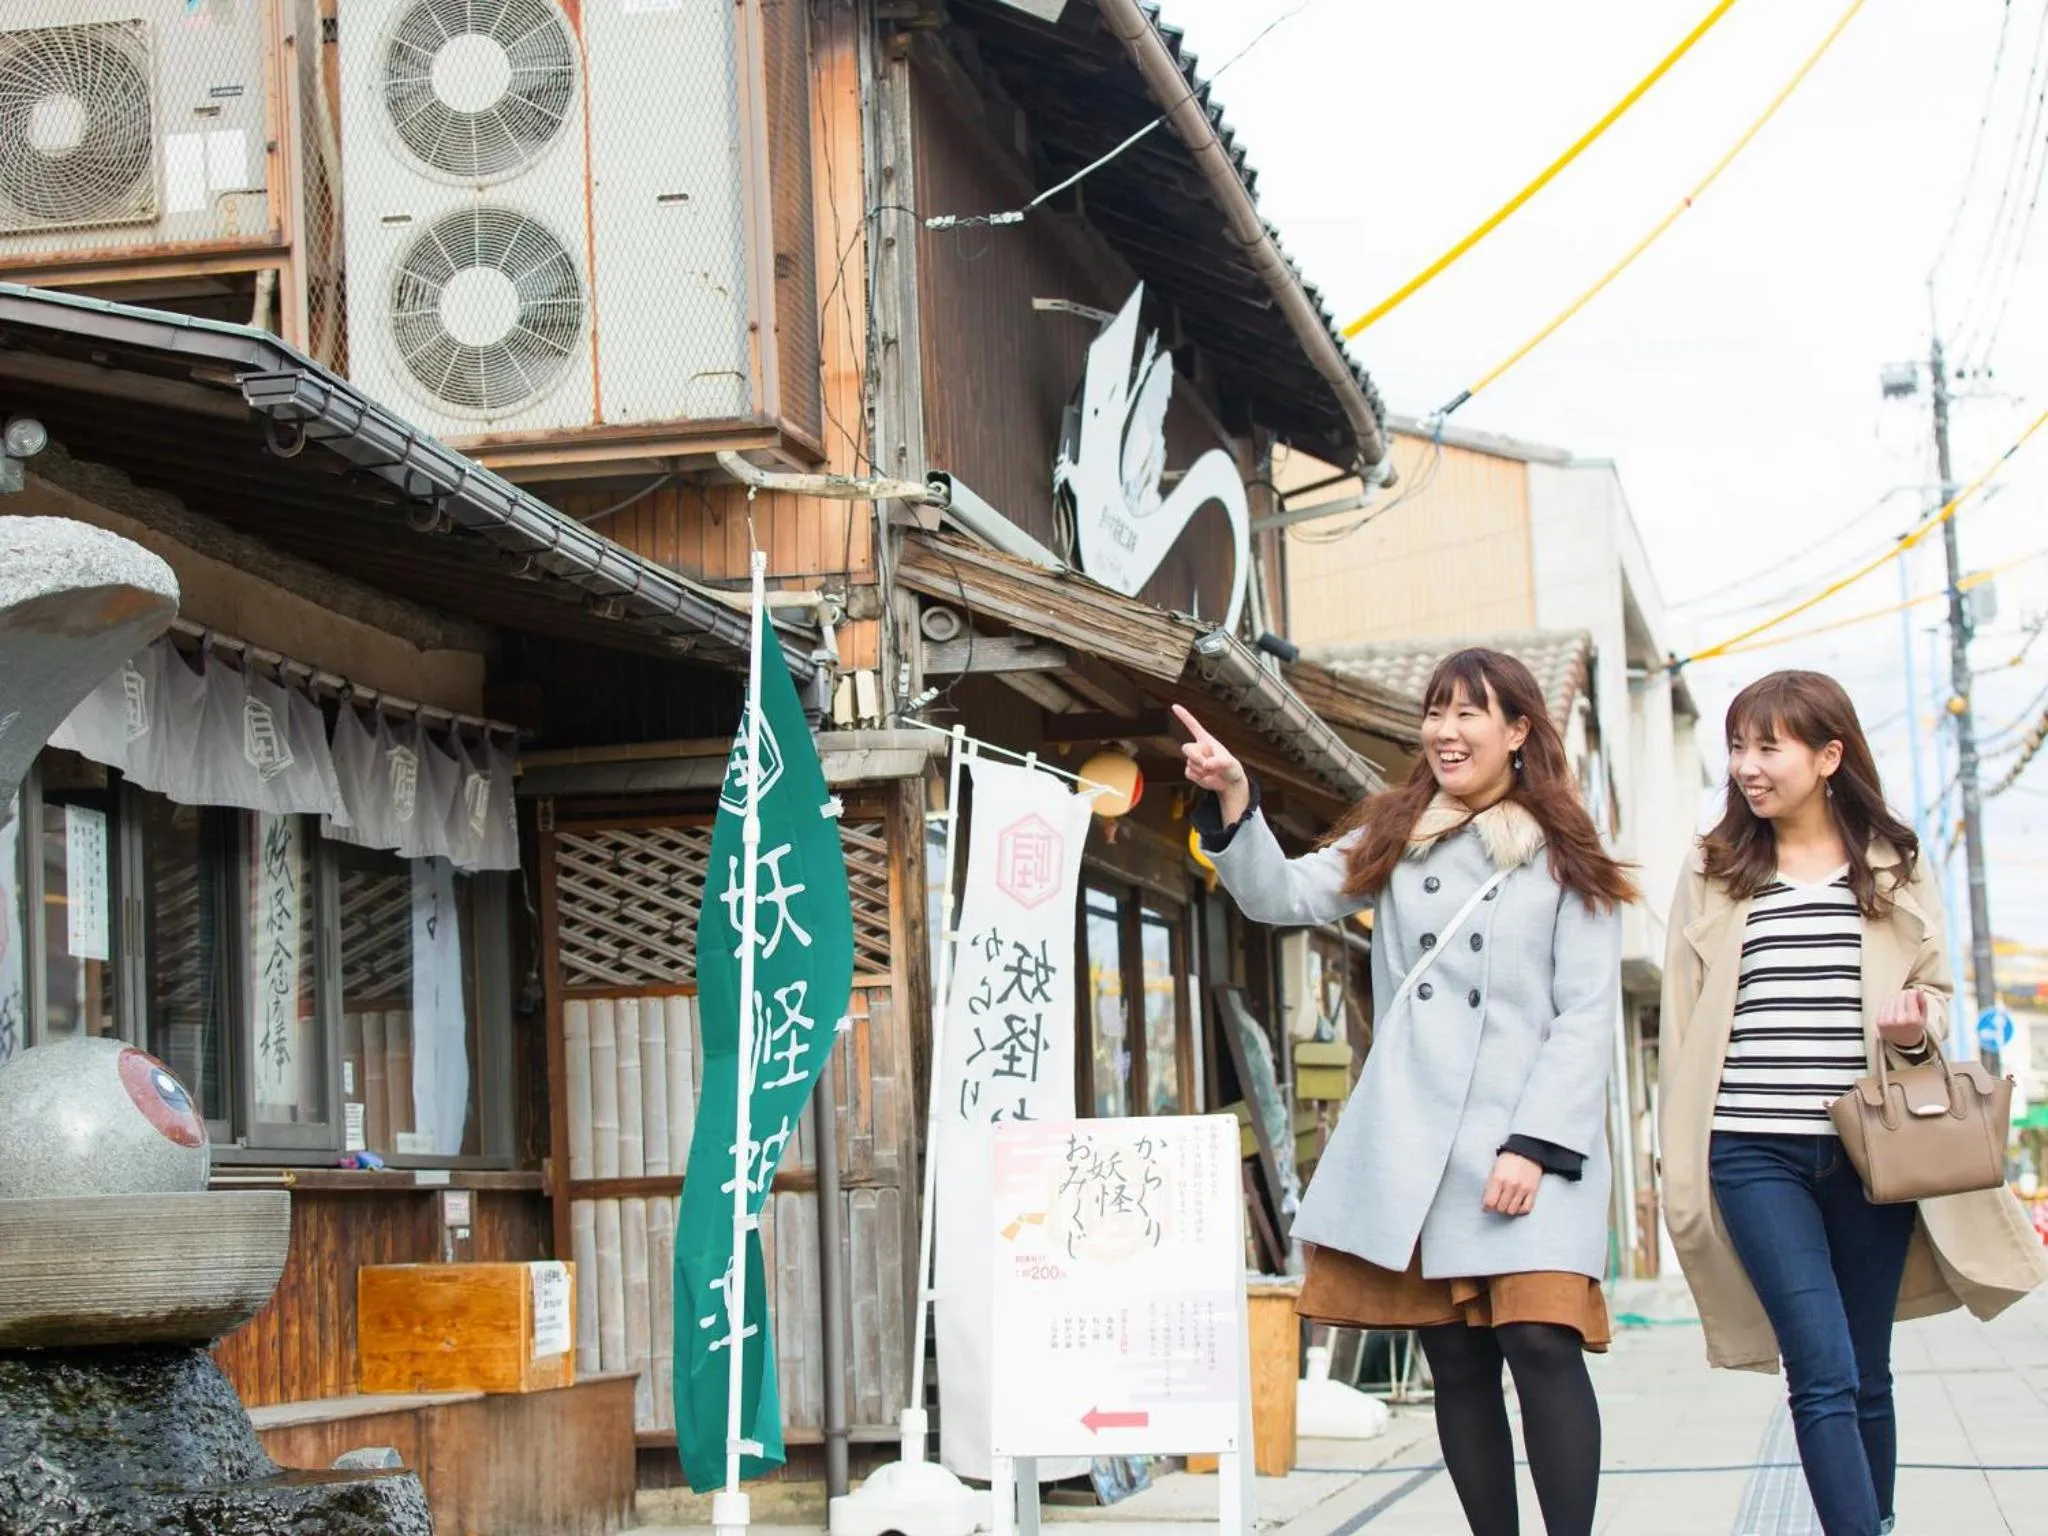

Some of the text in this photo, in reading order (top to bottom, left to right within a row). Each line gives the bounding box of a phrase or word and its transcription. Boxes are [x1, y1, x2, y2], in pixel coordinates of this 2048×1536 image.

[1059, 1133, 1094, 1260] おみくじ
[1090, 1151, 1133, 1217] 妖怪
[1134, 1135, 1168, 1248] からくり
